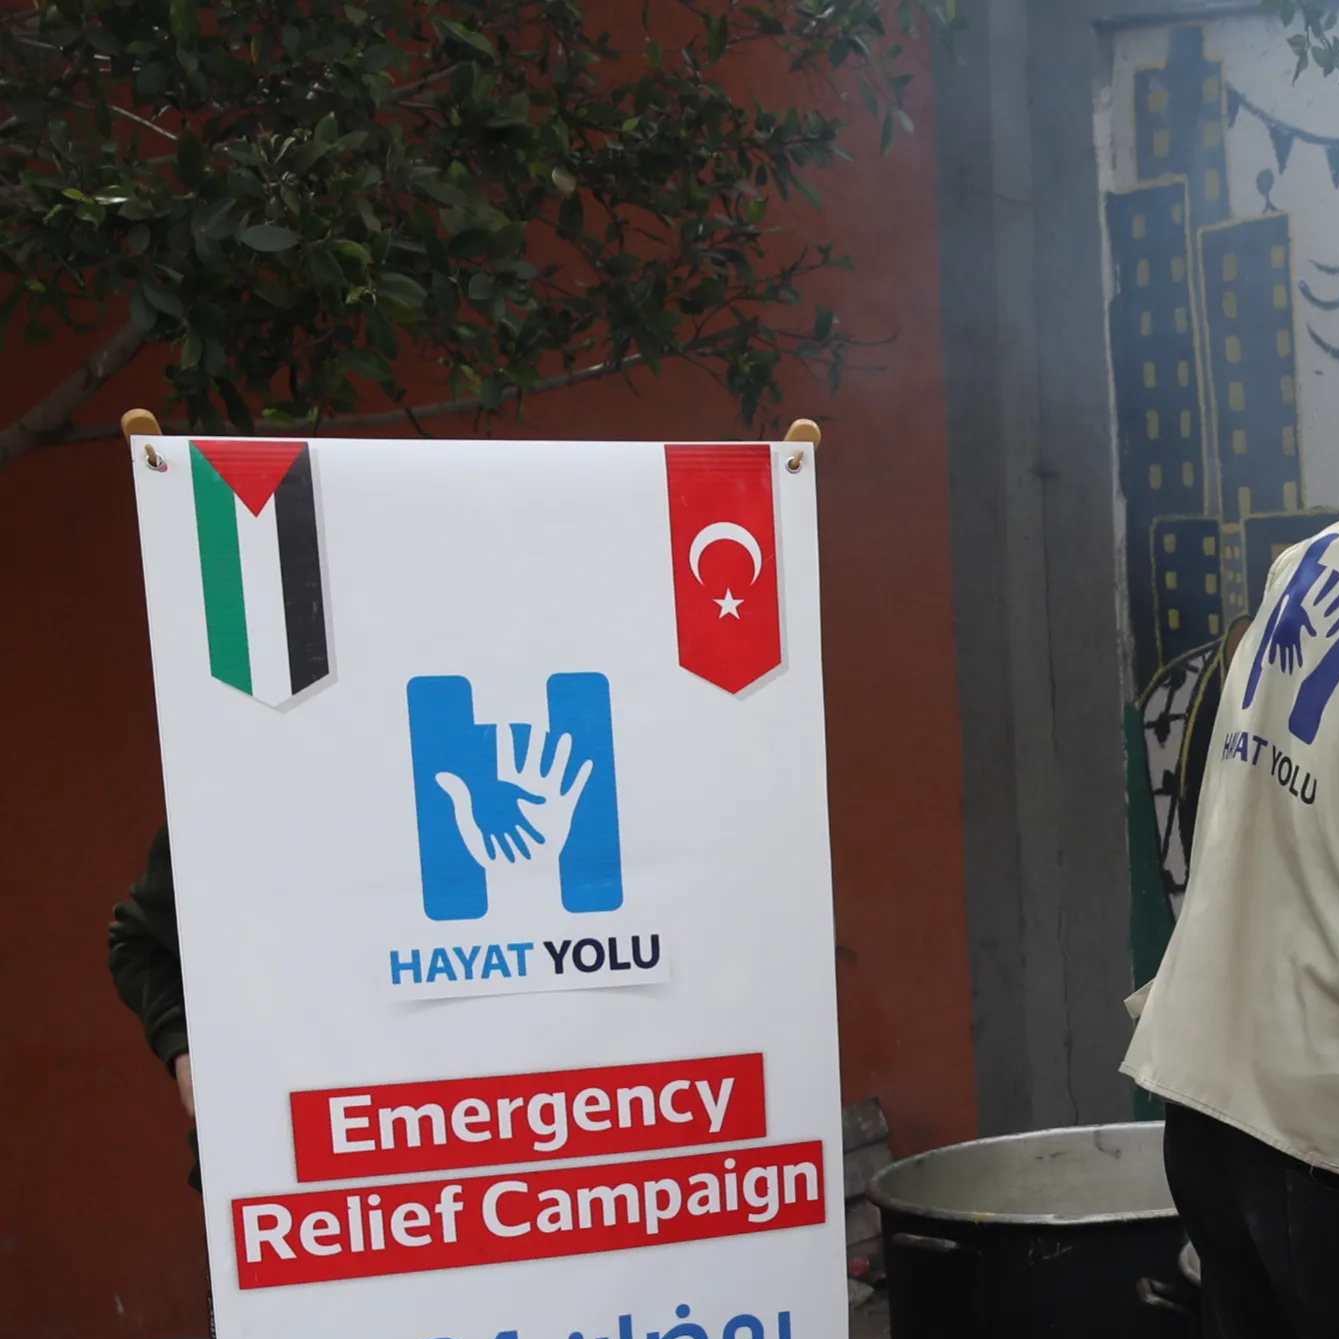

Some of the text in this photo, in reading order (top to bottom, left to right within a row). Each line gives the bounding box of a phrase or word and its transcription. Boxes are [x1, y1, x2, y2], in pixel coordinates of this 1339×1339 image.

[1270, 744, 1318, 805] YOLU
[390, 934, 660, 985] HAYAT YOLU
[328, 1076, 736, 1154] Emergency
[241, 1158, 820, 1263] Relief Campaign
